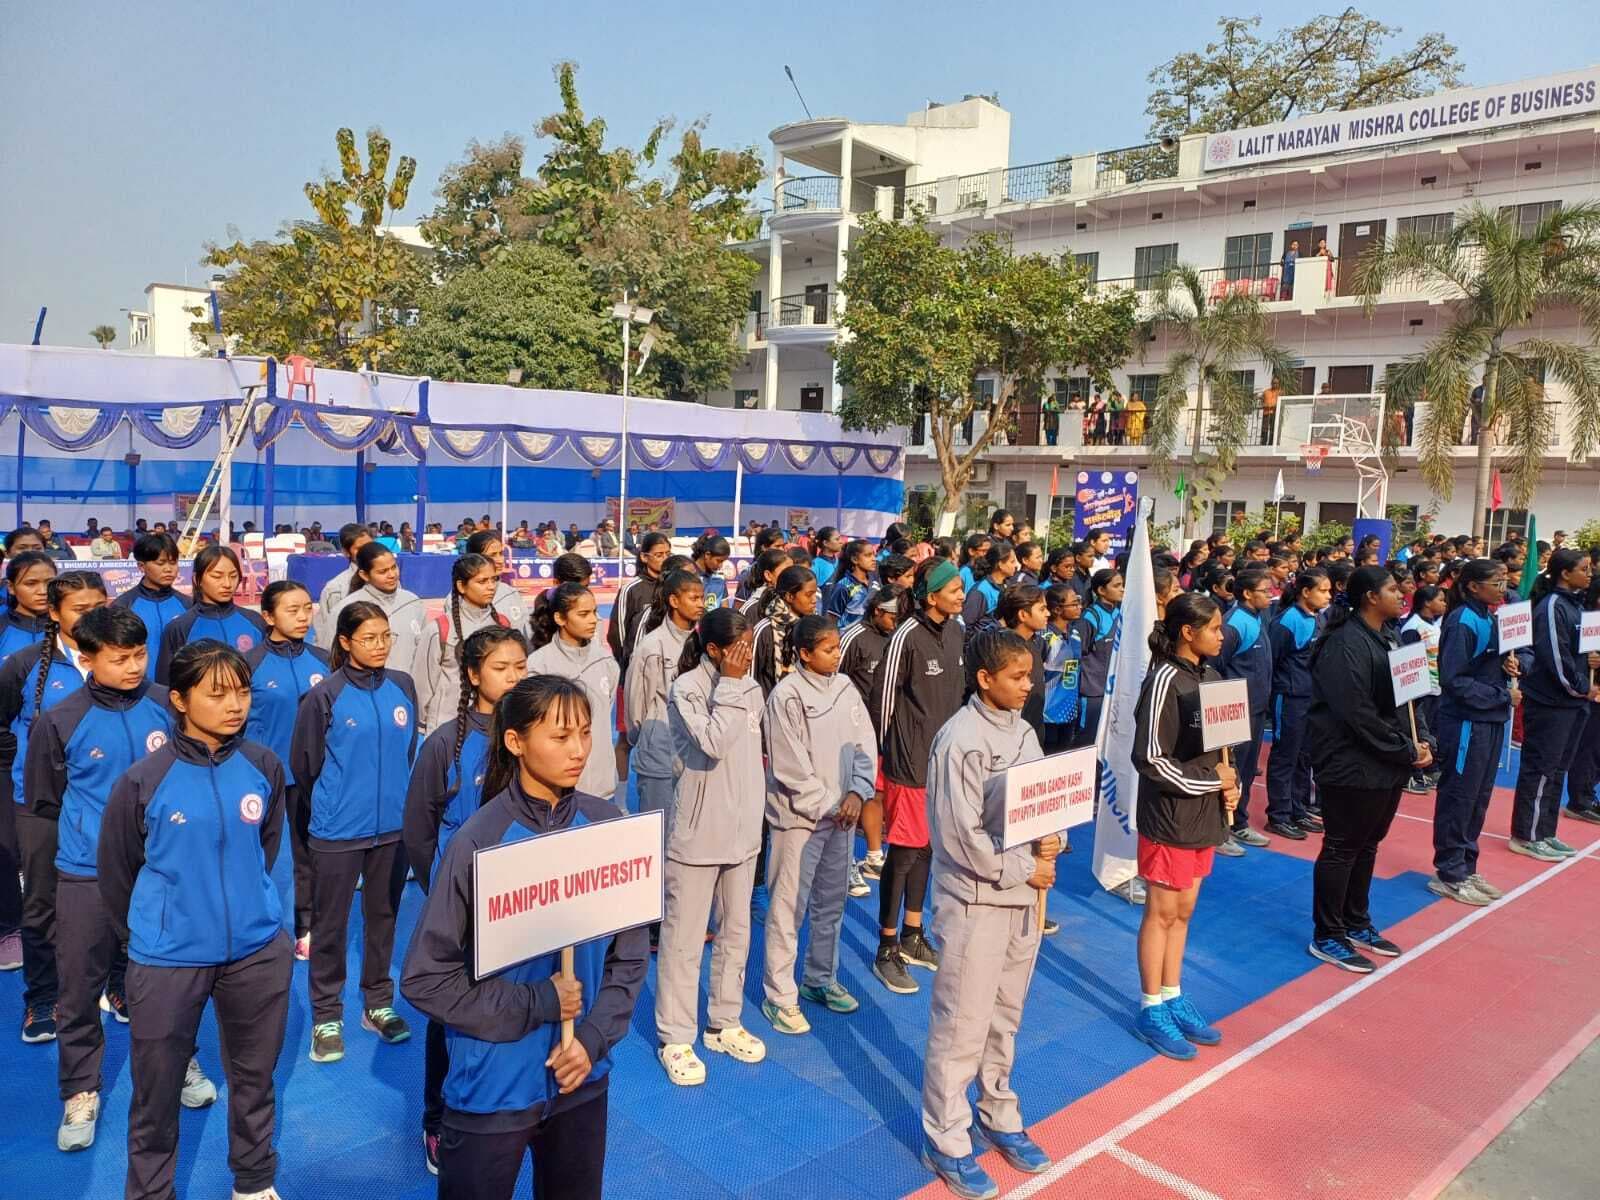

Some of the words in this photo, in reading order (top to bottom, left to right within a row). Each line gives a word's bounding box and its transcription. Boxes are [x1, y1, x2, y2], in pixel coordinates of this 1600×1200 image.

[1238, 133, 1274, 158] LALIT
[1277, 123, 1341, 151] NARAYAN
[1348, 112, 1404, 141] MISHRA
[1409, 99, 1480, 132] COLLEGE
[1485, 94, 1506, 119] OF
[1510, 79, 1597, 115] BUSINESS
[1219, 702, 1245, 723] UNIVERSITY
[1021, 781, 1047, 801] MAHATMA
[1047, 775, 1066, 793] GANDHI
[1068, 771, 1083, 788] KASHI
[1008, 801, 1035, 824] VIDYAPITH
[1069, 787, 1093, 805] VARANASI
[488, 878, 560, 922] MANIPUR
[564, 855, 652, 899] UNIVERSITY
